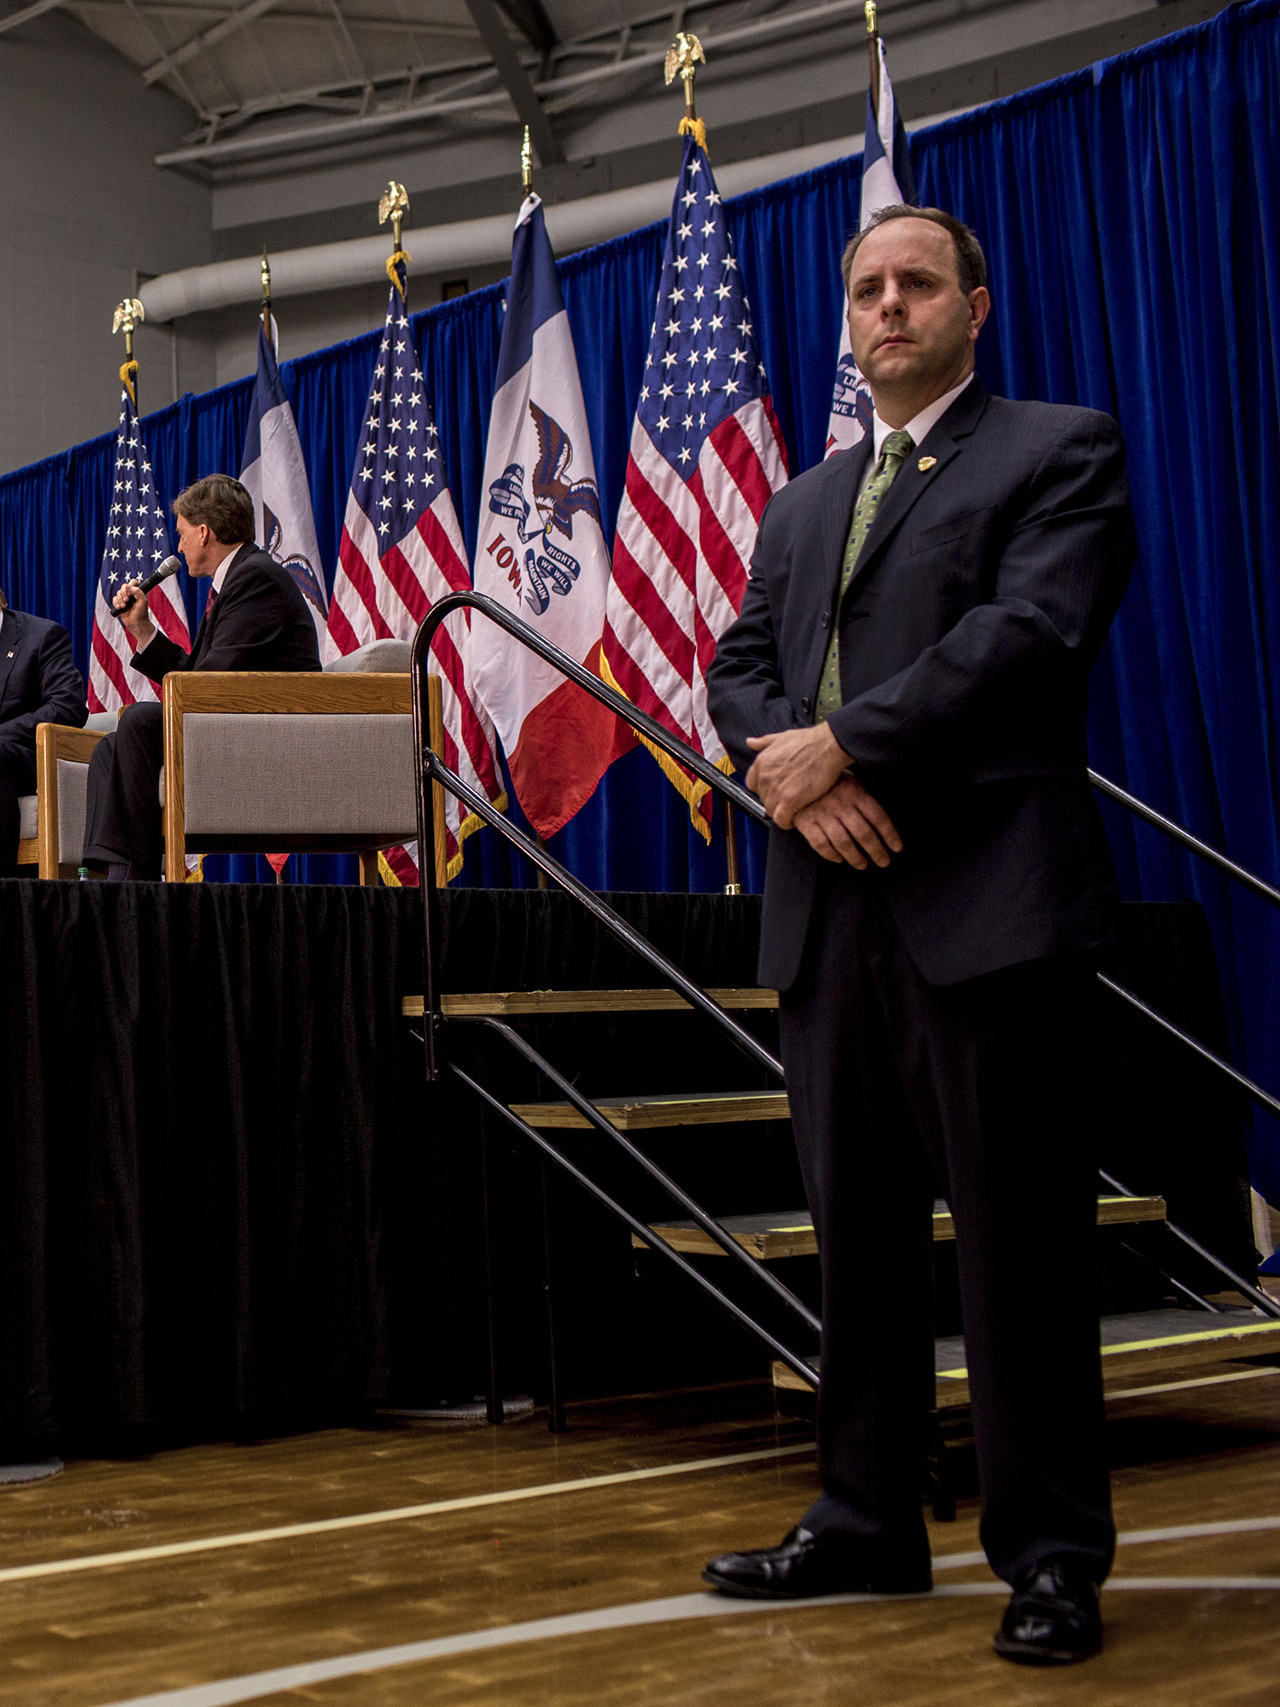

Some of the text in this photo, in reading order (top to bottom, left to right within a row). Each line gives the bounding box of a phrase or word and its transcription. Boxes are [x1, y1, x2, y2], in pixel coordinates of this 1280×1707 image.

[833, 401, 849, 414] WE
[501, 506, 514, 516] WE
[486, 531, 522, 602] IOW
[546, 546, 577, 570] RIGHTS
[527, 560, 548, 600] MAINTAIN
[540, 559, 569, 590] WE WILL
